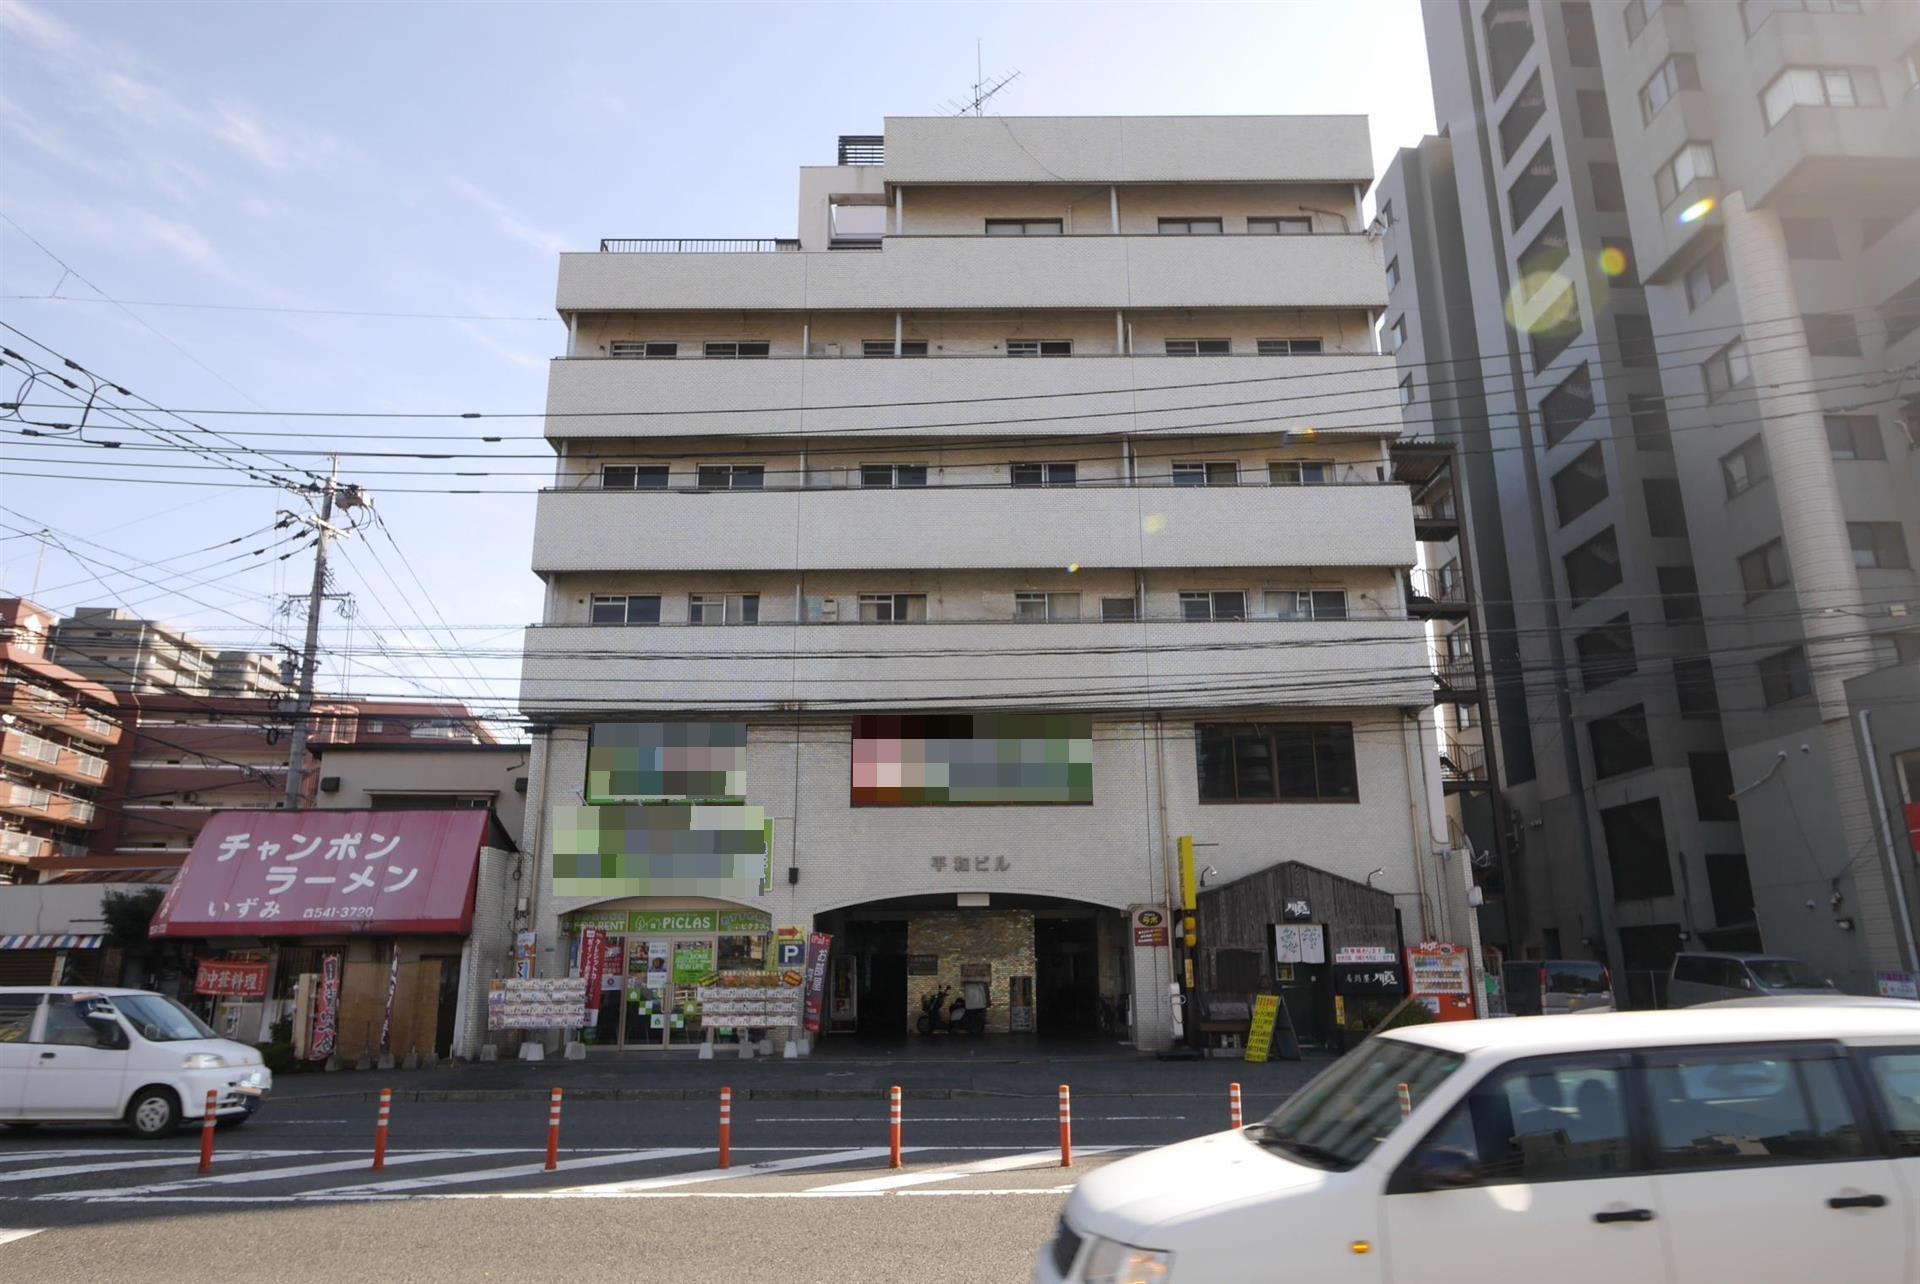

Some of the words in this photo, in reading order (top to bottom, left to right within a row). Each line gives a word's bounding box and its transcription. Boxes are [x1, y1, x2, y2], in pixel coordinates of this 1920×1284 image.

[217, 832, 401, 862] チャンポン
[931, 855, 1011, 872] 平和ビル
[265, 865, 418, 895] ラーメン
[208, 897, 281, 919] いずみ
[597, 921, 625, 931] RENT
[784, 945, 799, 963] P
[207, 969, 258, 992] 中華料理
